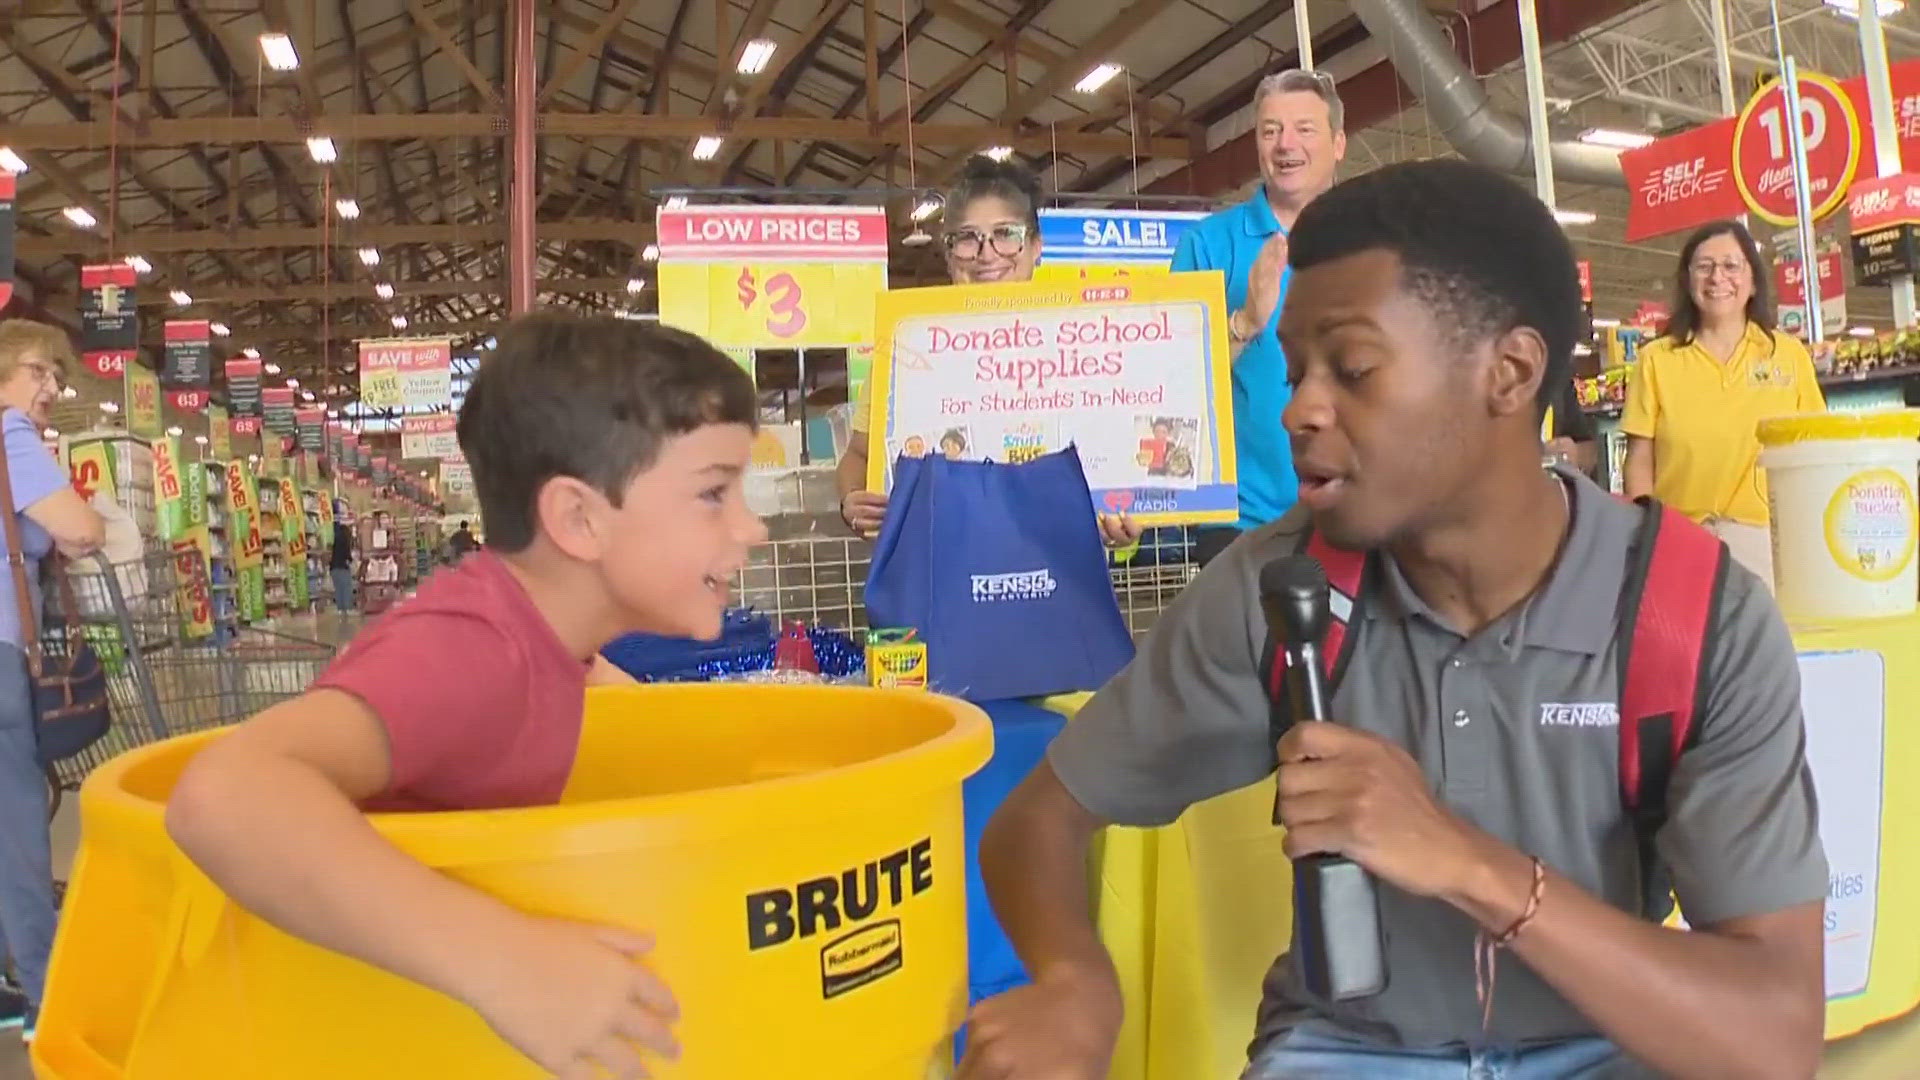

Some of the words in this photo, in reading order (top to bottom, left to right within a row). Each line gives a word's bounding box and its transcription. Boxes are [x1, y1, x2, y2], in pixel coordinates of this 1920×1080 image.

[1759, 97, 1827, 160] 10
[1662, 157, 1705, 184] SELF
[1758, 165, 1795, 193] Item
[1646, 176, 1703, 207] CHECK
[686, 218, 753, 241] LOW
[761, 218, 861, 241] PRICES
[1082, 219, 1167, 247] SALE!
[1784, 259, 1831, 284] SAE
[928, 319, 1044, 354] Donate
[98, 355, 123, 373] 64
[368, 351, 412, 367] SAVE
[415, 350, 441, 366] with
[976, 348, 1123, 391] Supplies
[941, 397, 973, 415] For
[979, 391, 1075, 413] Students
[1081, 385, 1164, 407] In-Need
[187, 463, 202, 524] COUPON
[1133, 500, 1177, 512] RADIO
[747, 836, 932, 951] BRUTE
[828, 929, 897, 969] Rubbermaid
